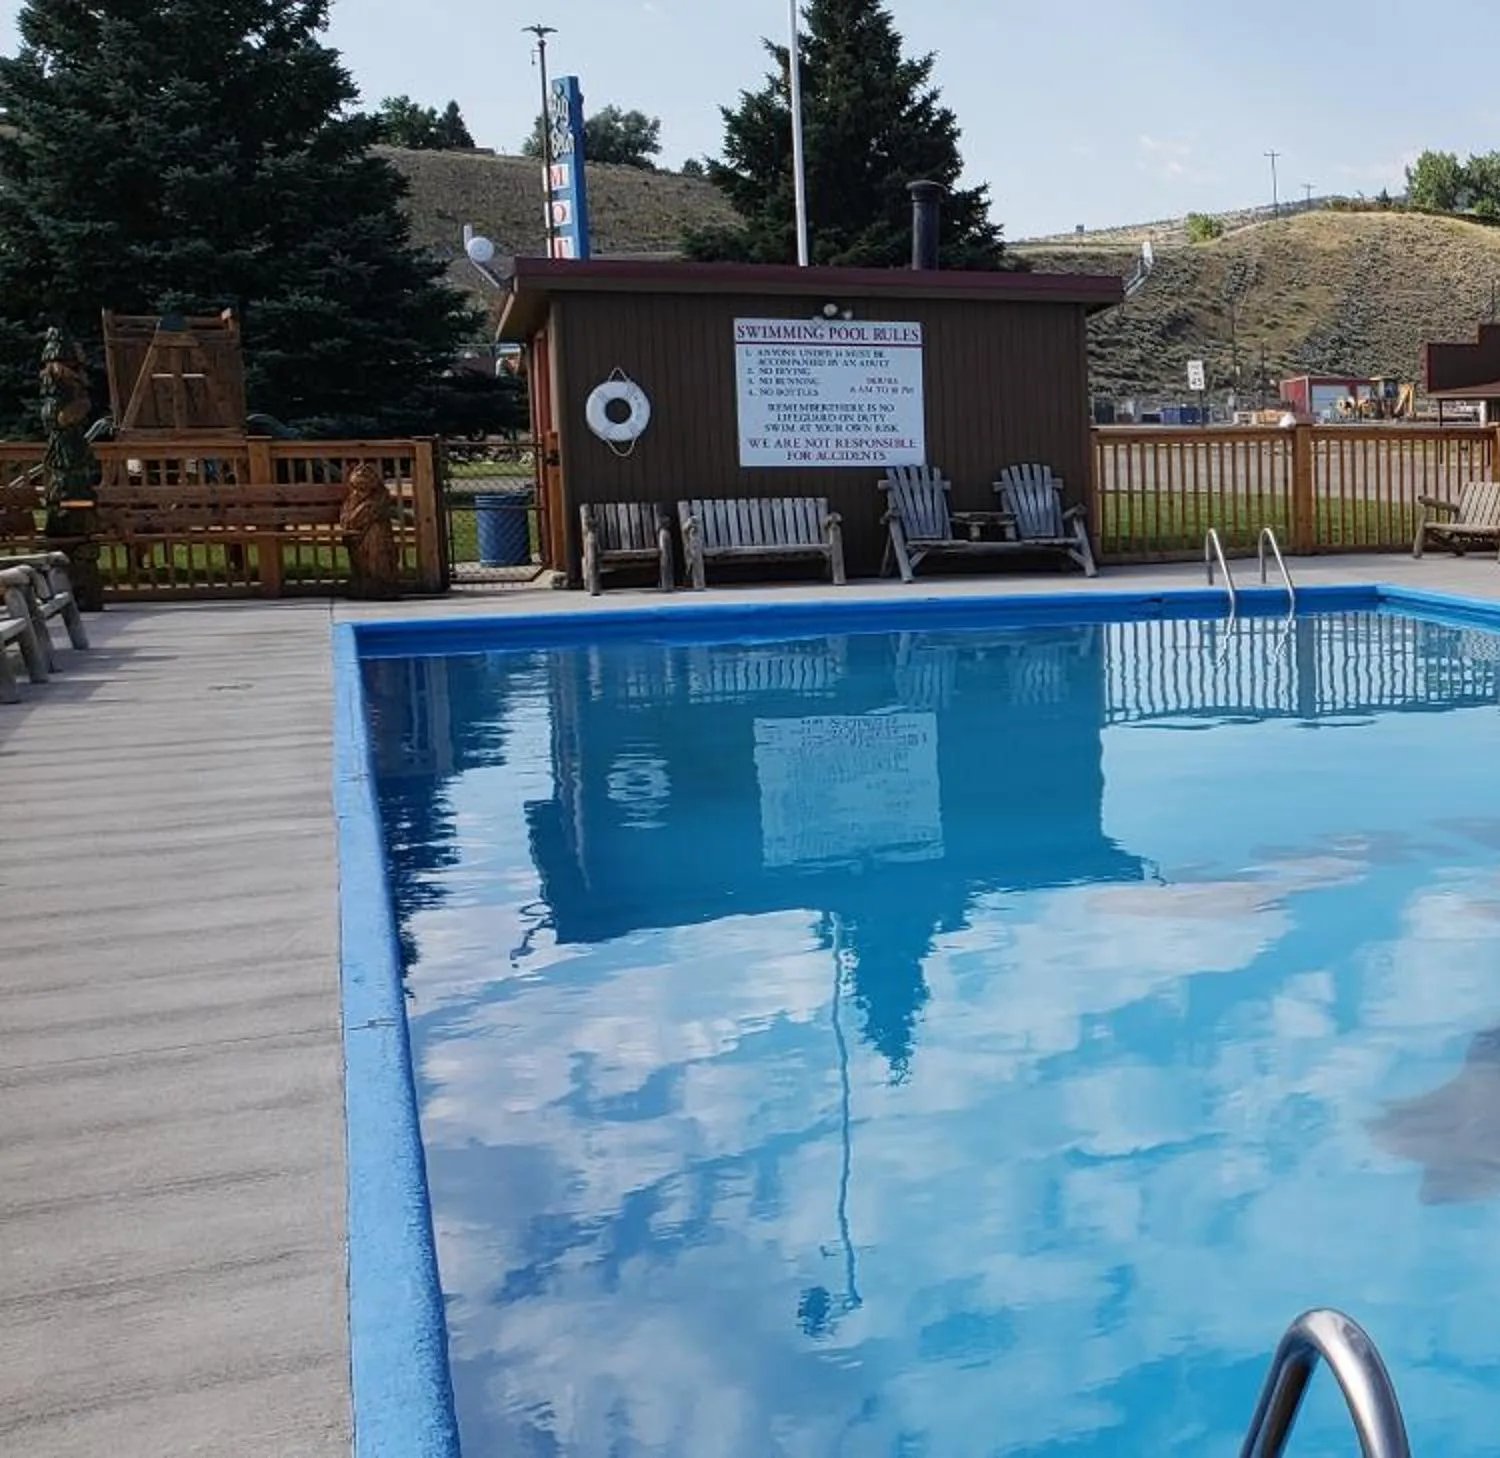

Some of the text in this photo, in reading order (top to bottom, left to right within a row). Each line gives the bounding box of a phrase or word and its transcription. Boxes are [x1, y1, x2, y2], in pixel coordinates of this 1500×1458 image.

[737, 325, 919, 342] SWIMMING POOL RULES
[759, 367, 772, 375] NO
[775, 367, 811, 375] DIVING
[759, 377, 772, 385] NO
[775, 377, 819, 385] RUNNING
[759, 388, 773, 396] NO
[775, 388, 819, 397] BOTTLES
[879, 404, 895, 412] NO
[777, 413, 886, 423] LIFEGUARD ON DUTY
[764, 423, 795, 432] SWIM
[748, 438, 917, 449] WE ARE NOT RESPONSIBLE
[786, 451, 887, 461] FOR ACCIDENTS
